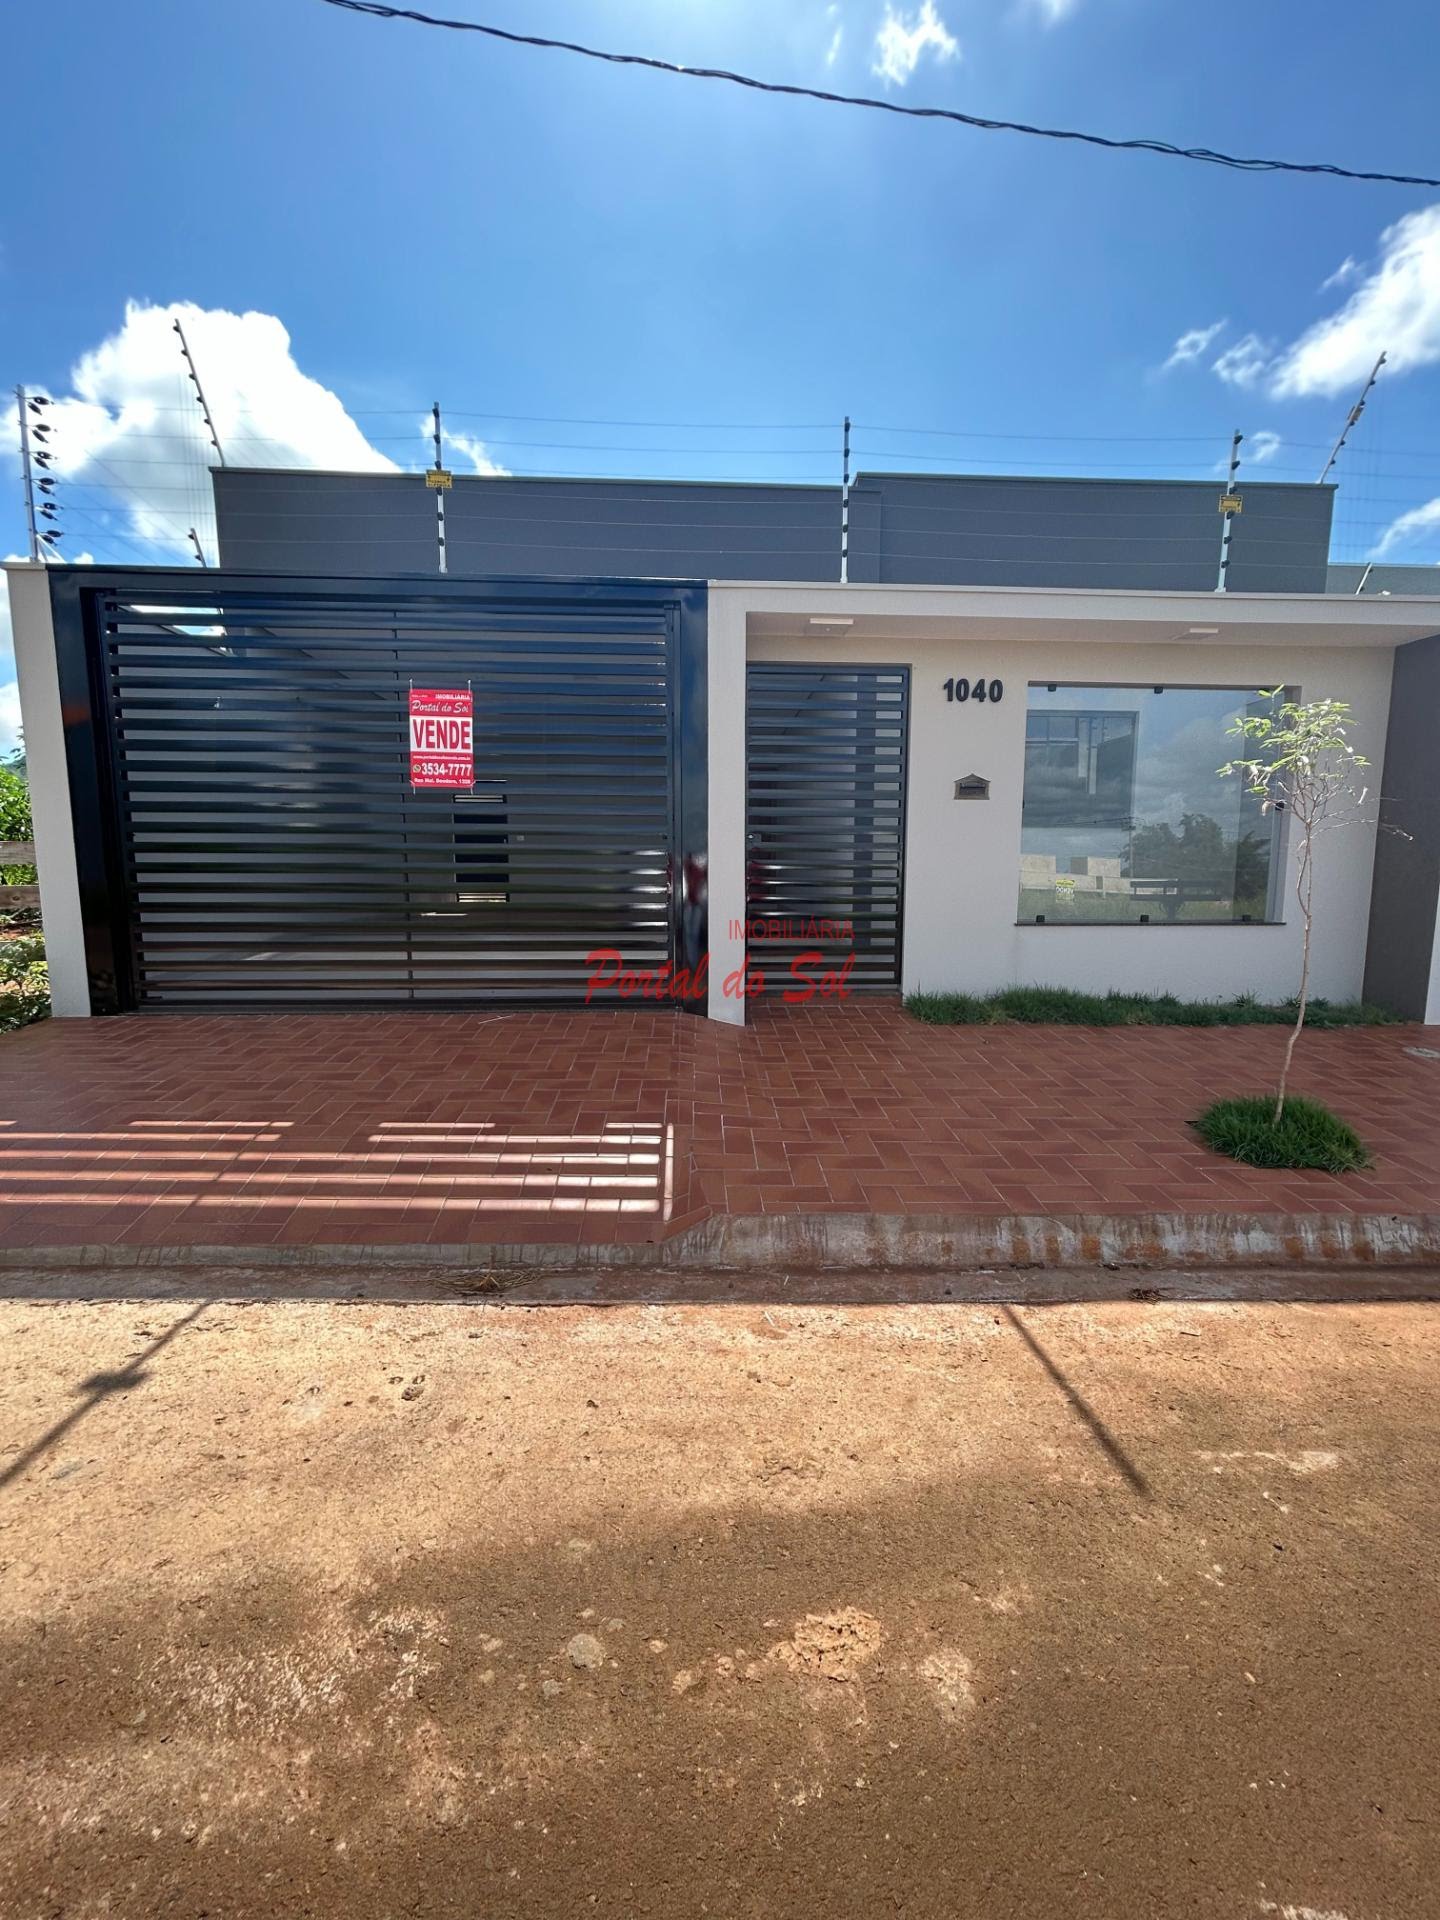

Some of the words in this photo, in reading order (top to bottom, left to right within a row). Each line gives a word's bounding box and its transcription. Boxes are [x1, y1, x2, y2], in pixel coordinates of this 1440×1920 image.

[942, 678, 1004, 703] 1040
[411, 699, 440, 712] Portal
[441, 702, 452, 712] do
[412, 719, 471, 750] VENDE
[421, 762, 472, 776] 3534-7777
